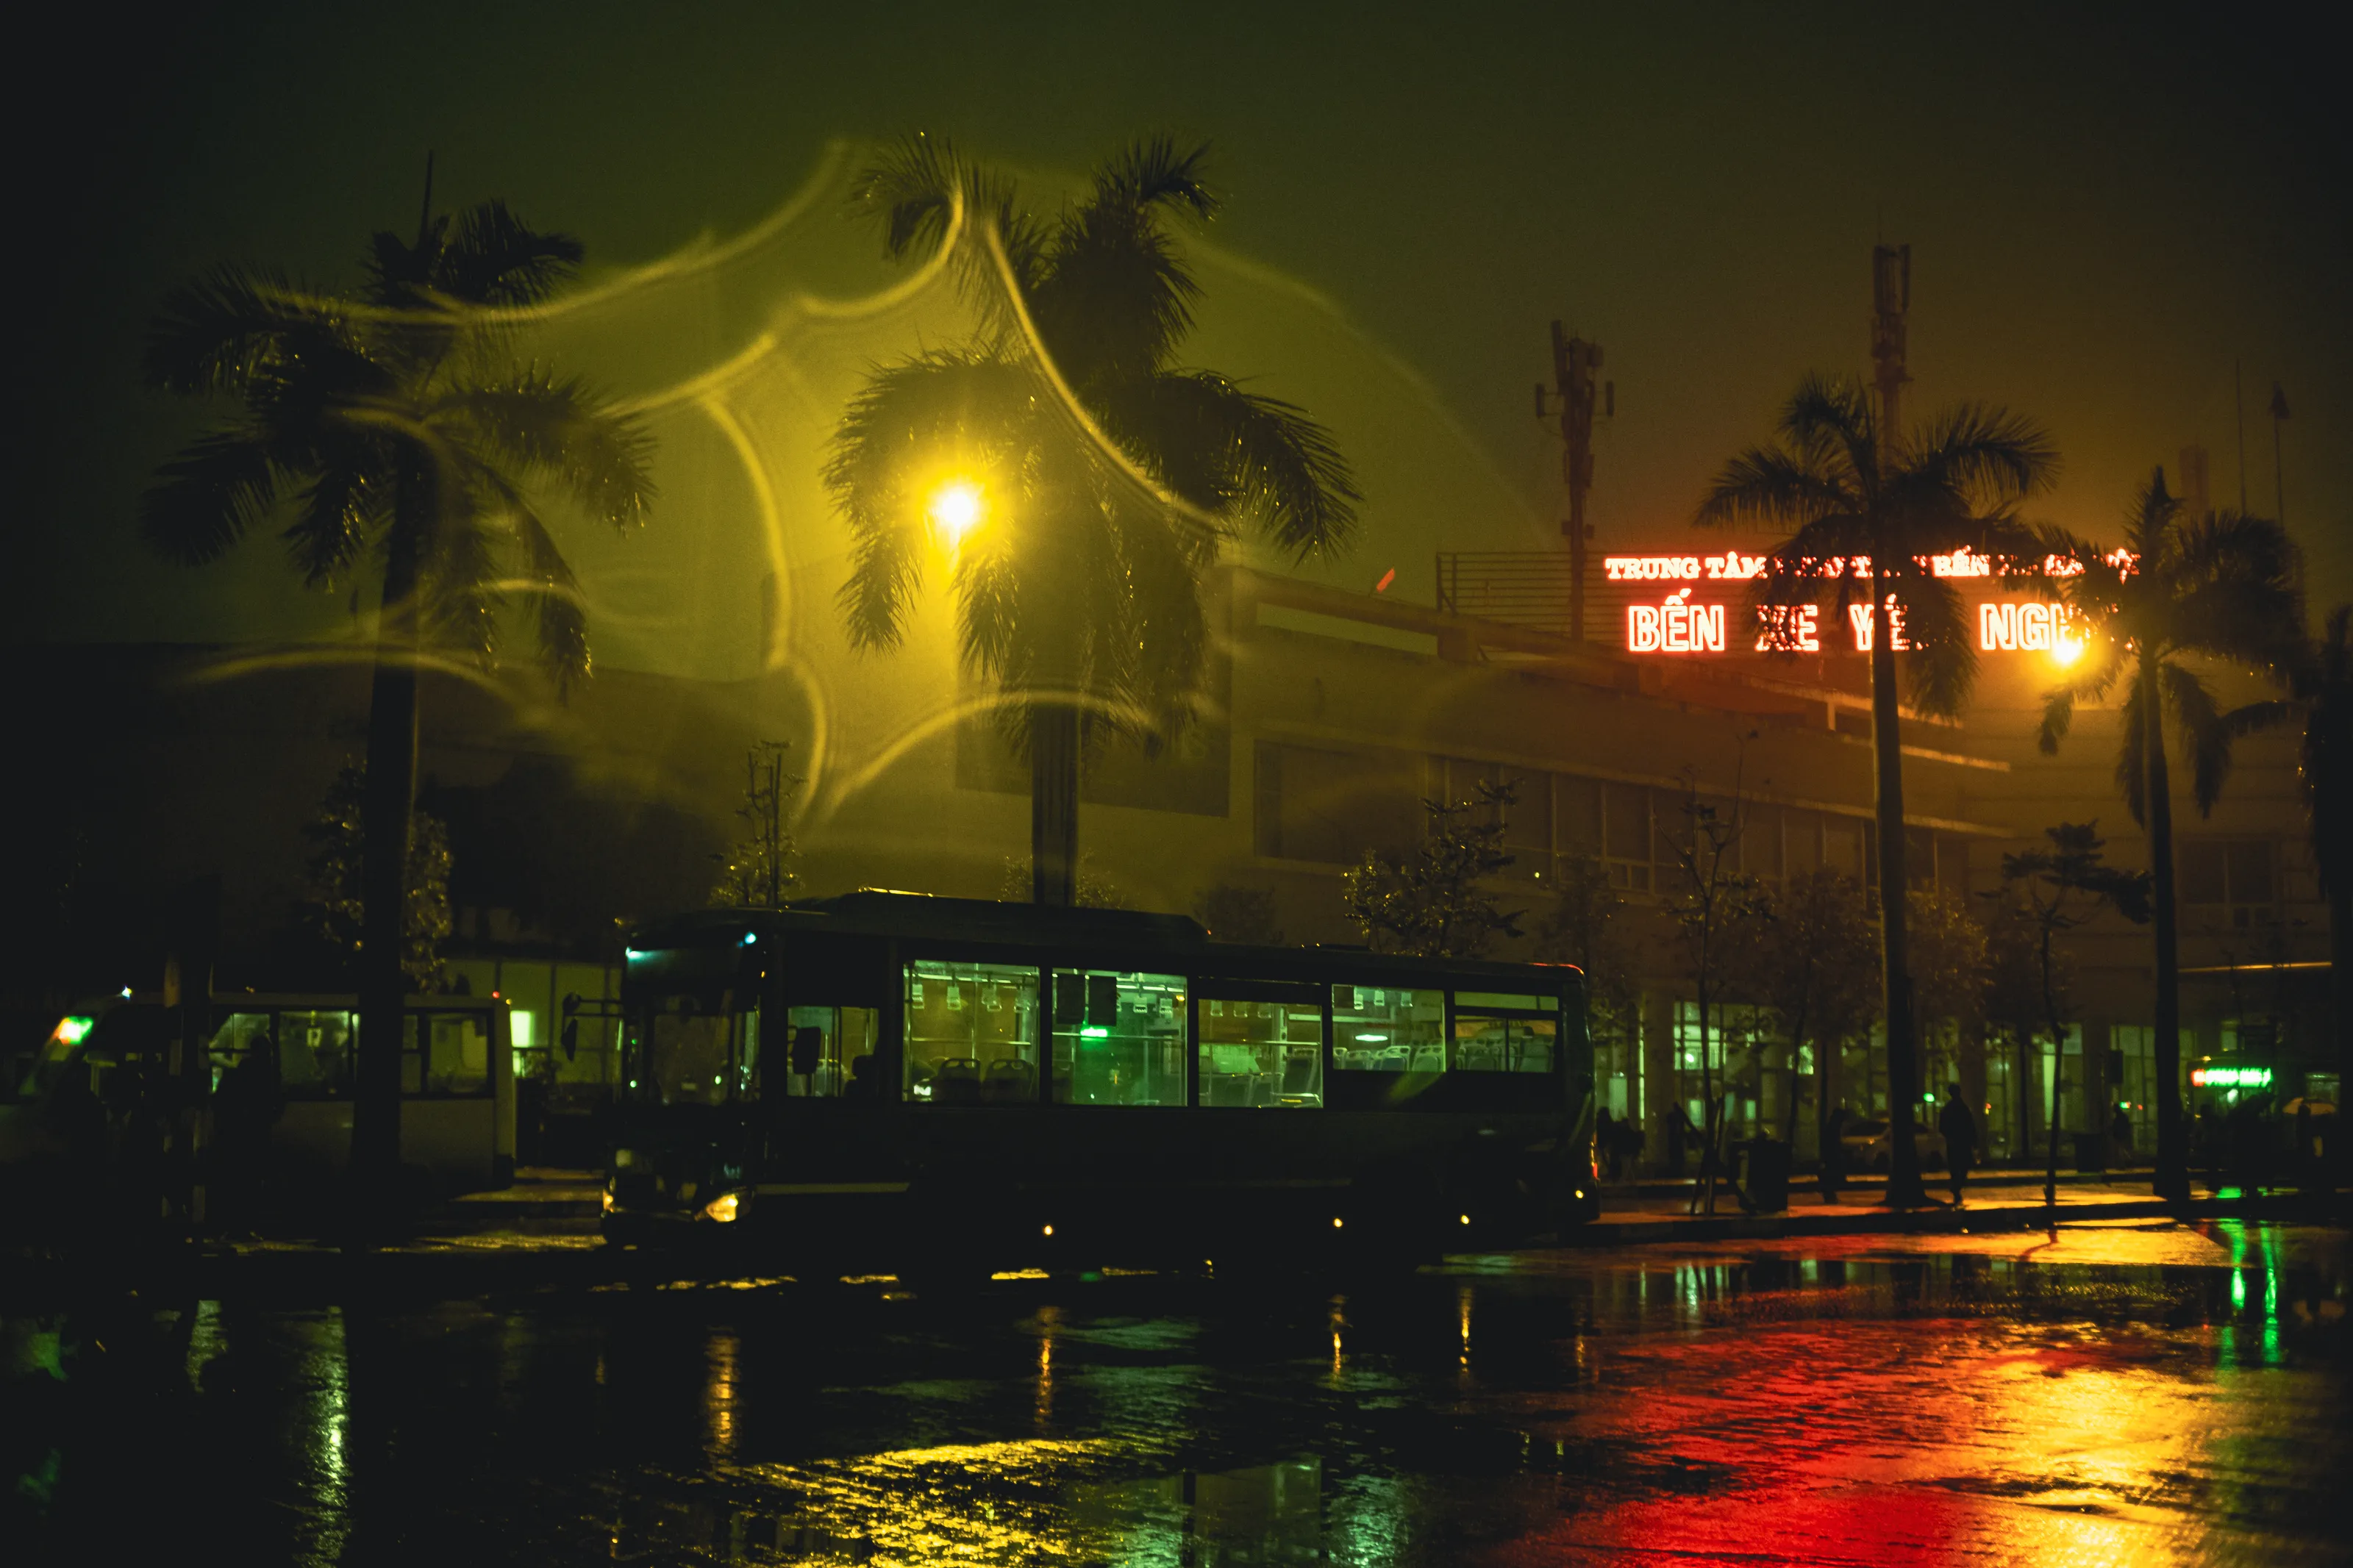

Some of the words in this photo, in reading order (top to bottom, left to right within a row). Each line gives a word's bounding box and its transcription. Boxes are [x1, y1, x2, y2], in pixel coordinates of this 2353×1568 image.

[1604, 556, 1702, 579] TRUNG
[1704, 551, 1768, 579] TÂM
[1931, 545, 1990, 577] BẾN
[1627, 587, 1725, 652] BẾN
[1754, 604, 1819, 652] XE
